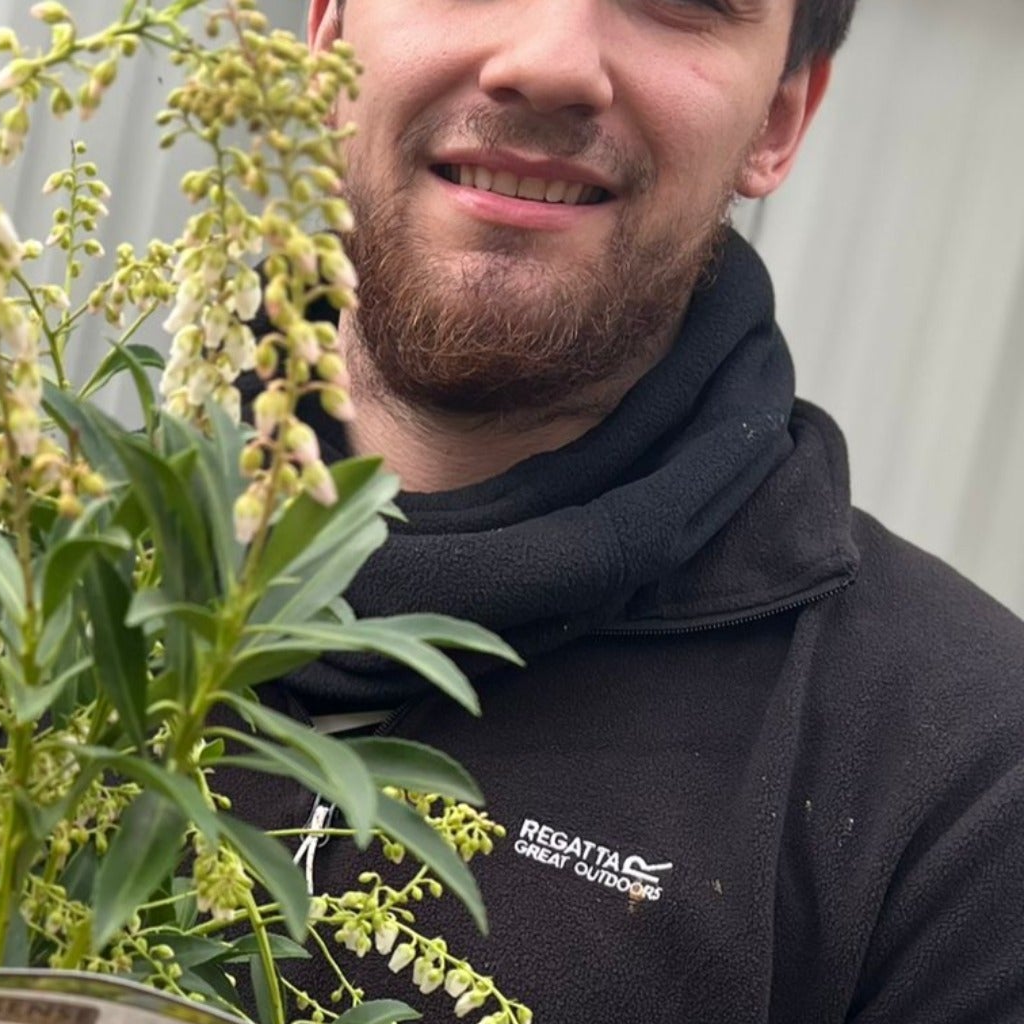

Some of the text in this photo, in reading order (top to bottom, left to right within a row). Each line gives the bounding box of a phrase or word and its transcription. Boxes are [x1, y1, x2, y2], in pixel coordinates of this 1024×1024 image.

[514, 840, 663, 901] GREAT OUTDOORS
[519, 818, 620, 872] REGATTA
